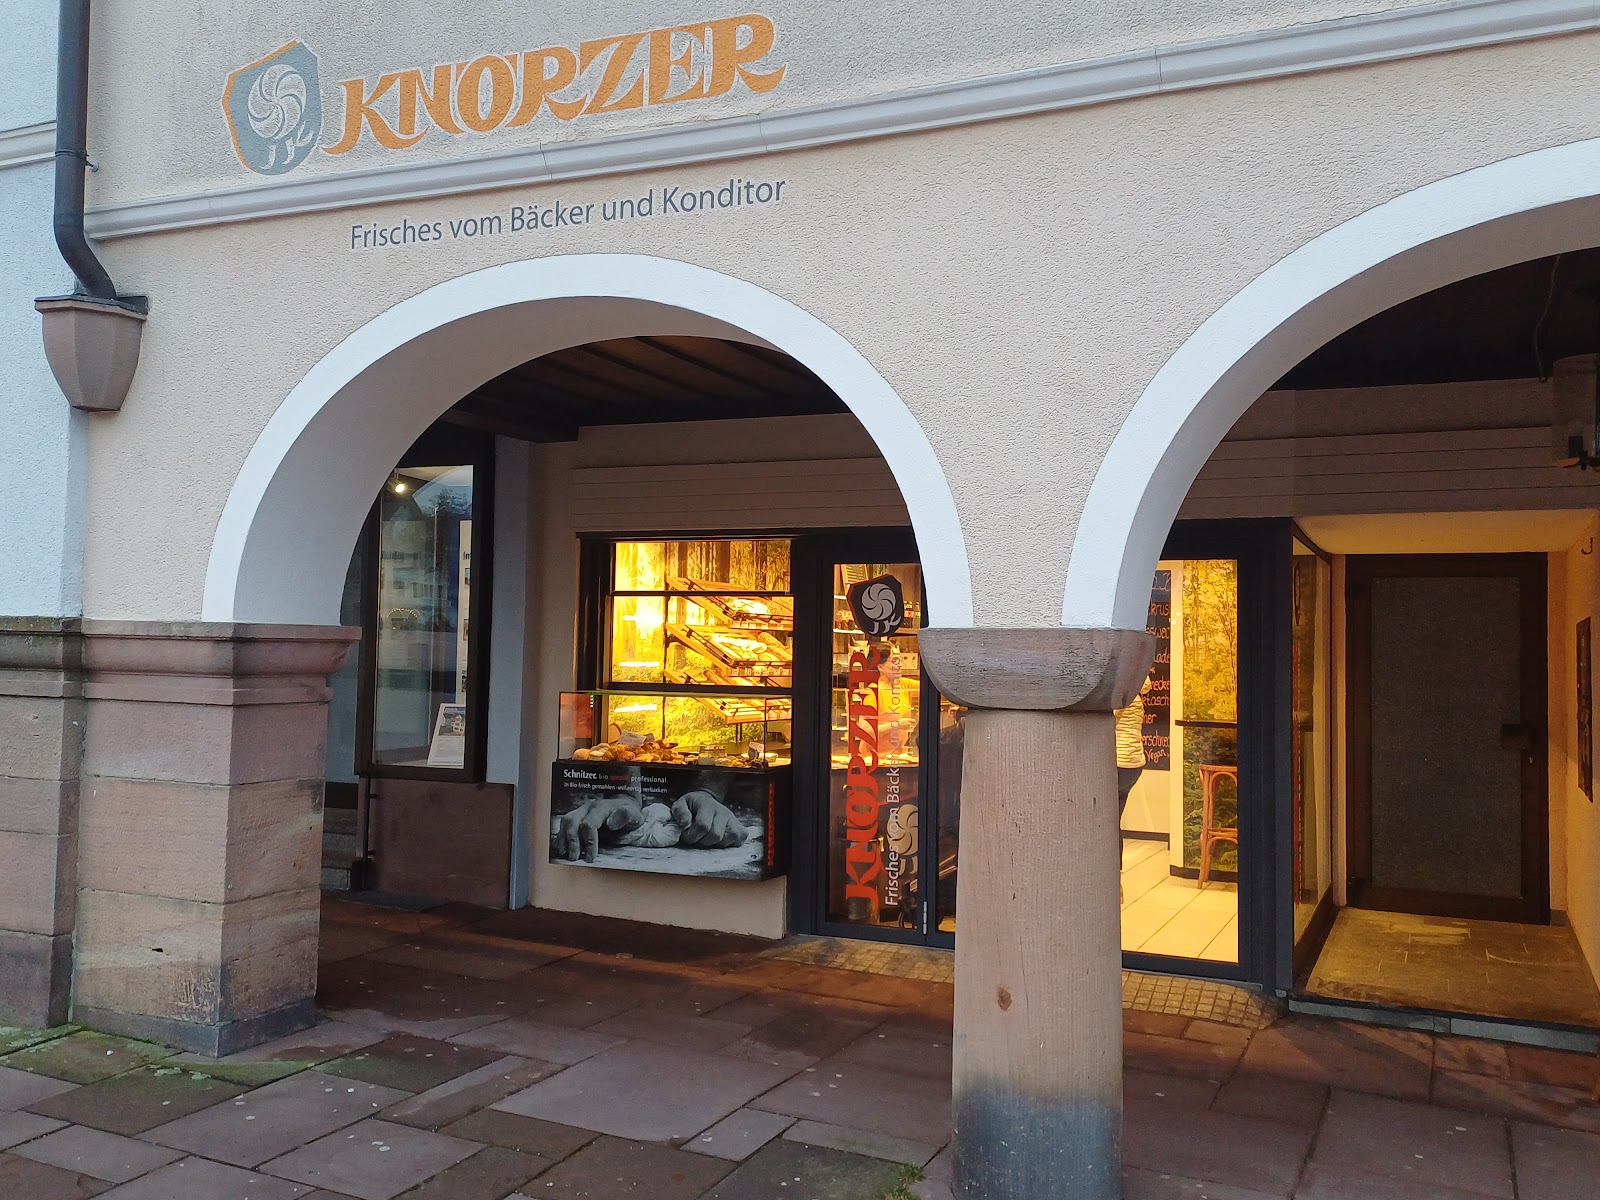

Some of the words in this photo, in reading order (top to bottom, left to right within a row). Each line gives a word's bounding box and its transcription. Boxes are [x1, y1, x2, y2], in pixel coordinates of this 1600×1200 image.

[321, 13, 788, 156] KNORZER
[350, 217, 443, 250] Frisches
[448, 213, 503, 240] vom
[510, 199, 595, 233] Bäcker
[601, 189, 654, 221] und
[662, 177, 787, 214] Konditor
[845, 645, 881, 908] KNORZER
[886, 752, 900, 803] Bäcker
[888, 806, 900, 841] vom
[884, 844, 899, 906] Frisches
